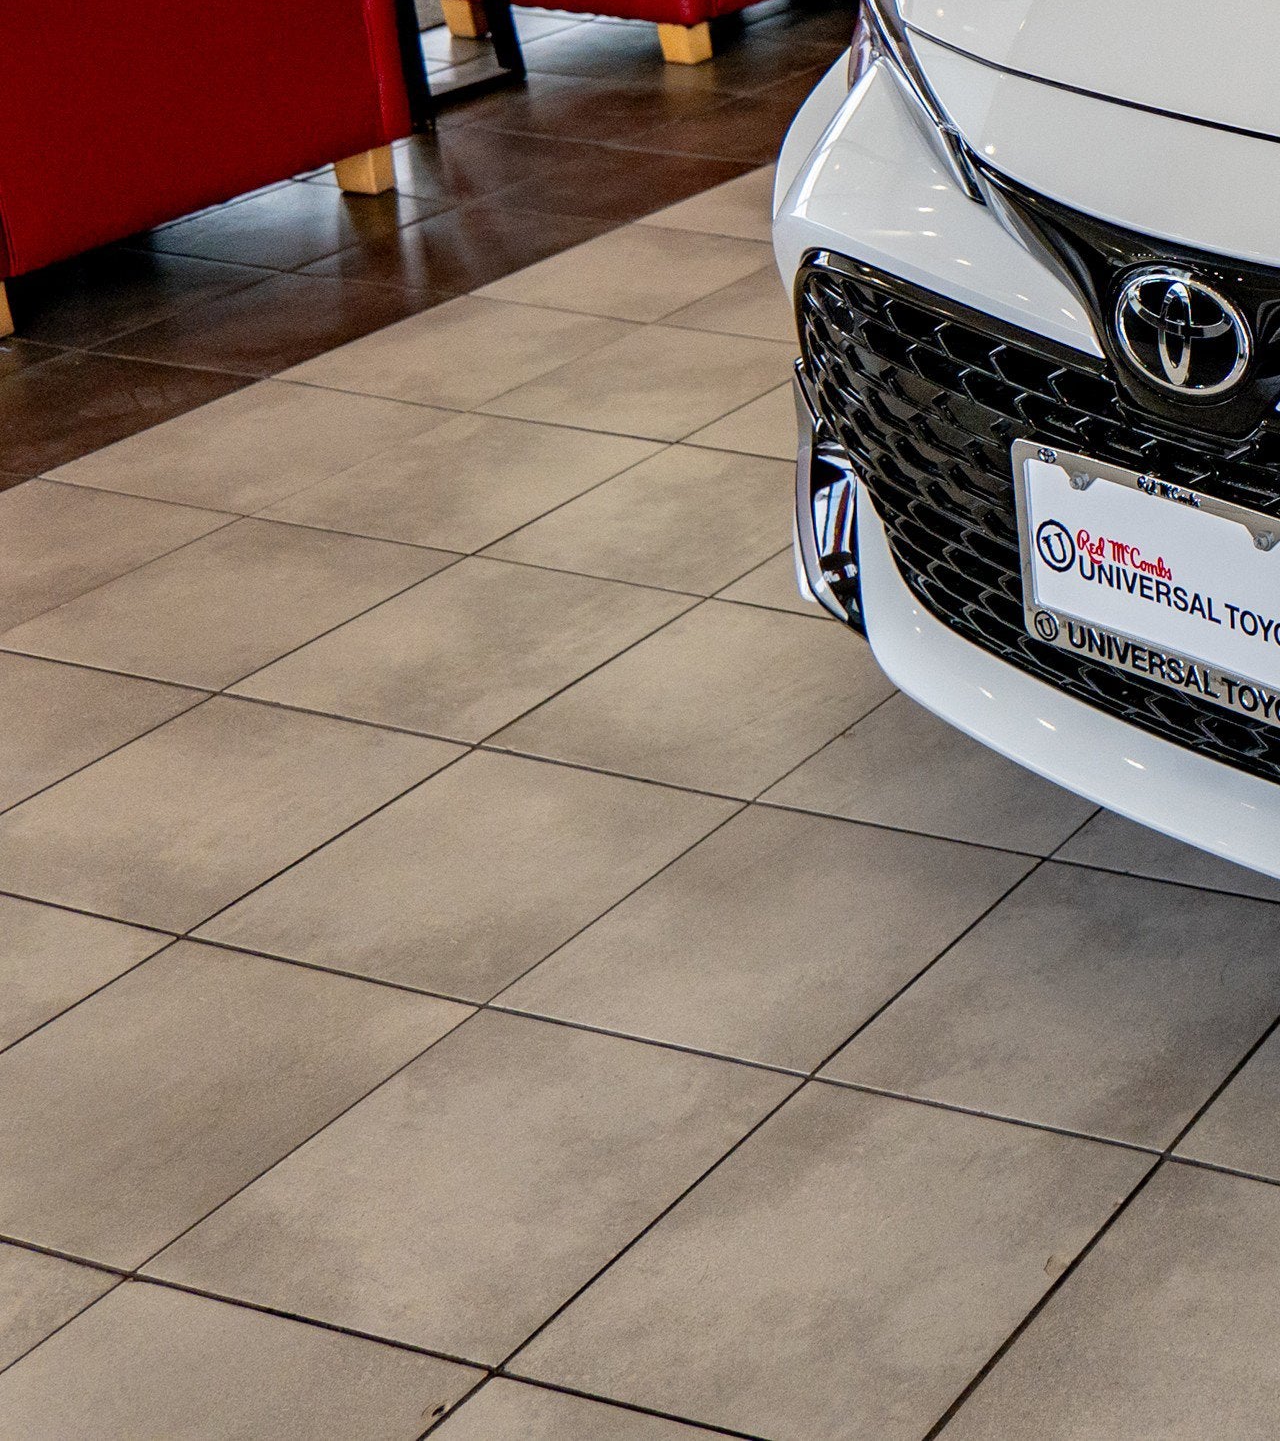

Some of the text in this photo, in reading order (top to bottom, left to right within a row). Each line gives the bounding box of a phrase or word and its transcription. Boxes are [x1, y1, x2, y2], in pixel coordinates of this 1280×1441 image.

[1076, 529, 1172, 581] Red McCombs
[1078, 554, 1222, 625] UNIVERSAL
[1067, 620, 1221, 699] UNIVERSAL
